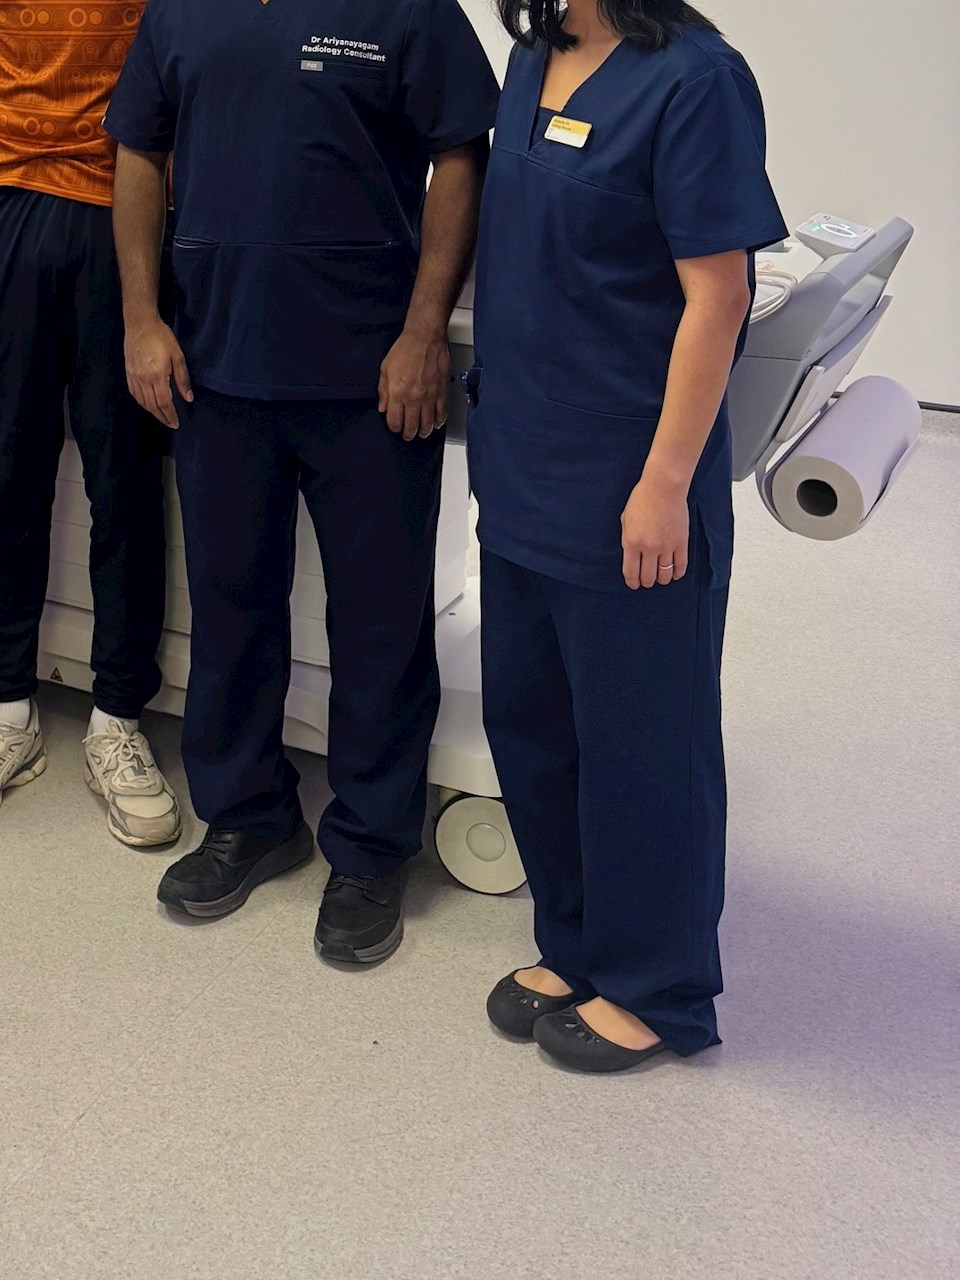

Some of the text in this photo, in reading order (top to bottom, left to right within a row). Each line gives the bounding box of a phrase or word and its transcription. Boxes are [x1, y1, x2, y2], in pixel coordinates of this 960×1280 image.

[323, 36, 379, 51] Ariyanayagam
[302, 45, 386, 62] Radiology Consultant
